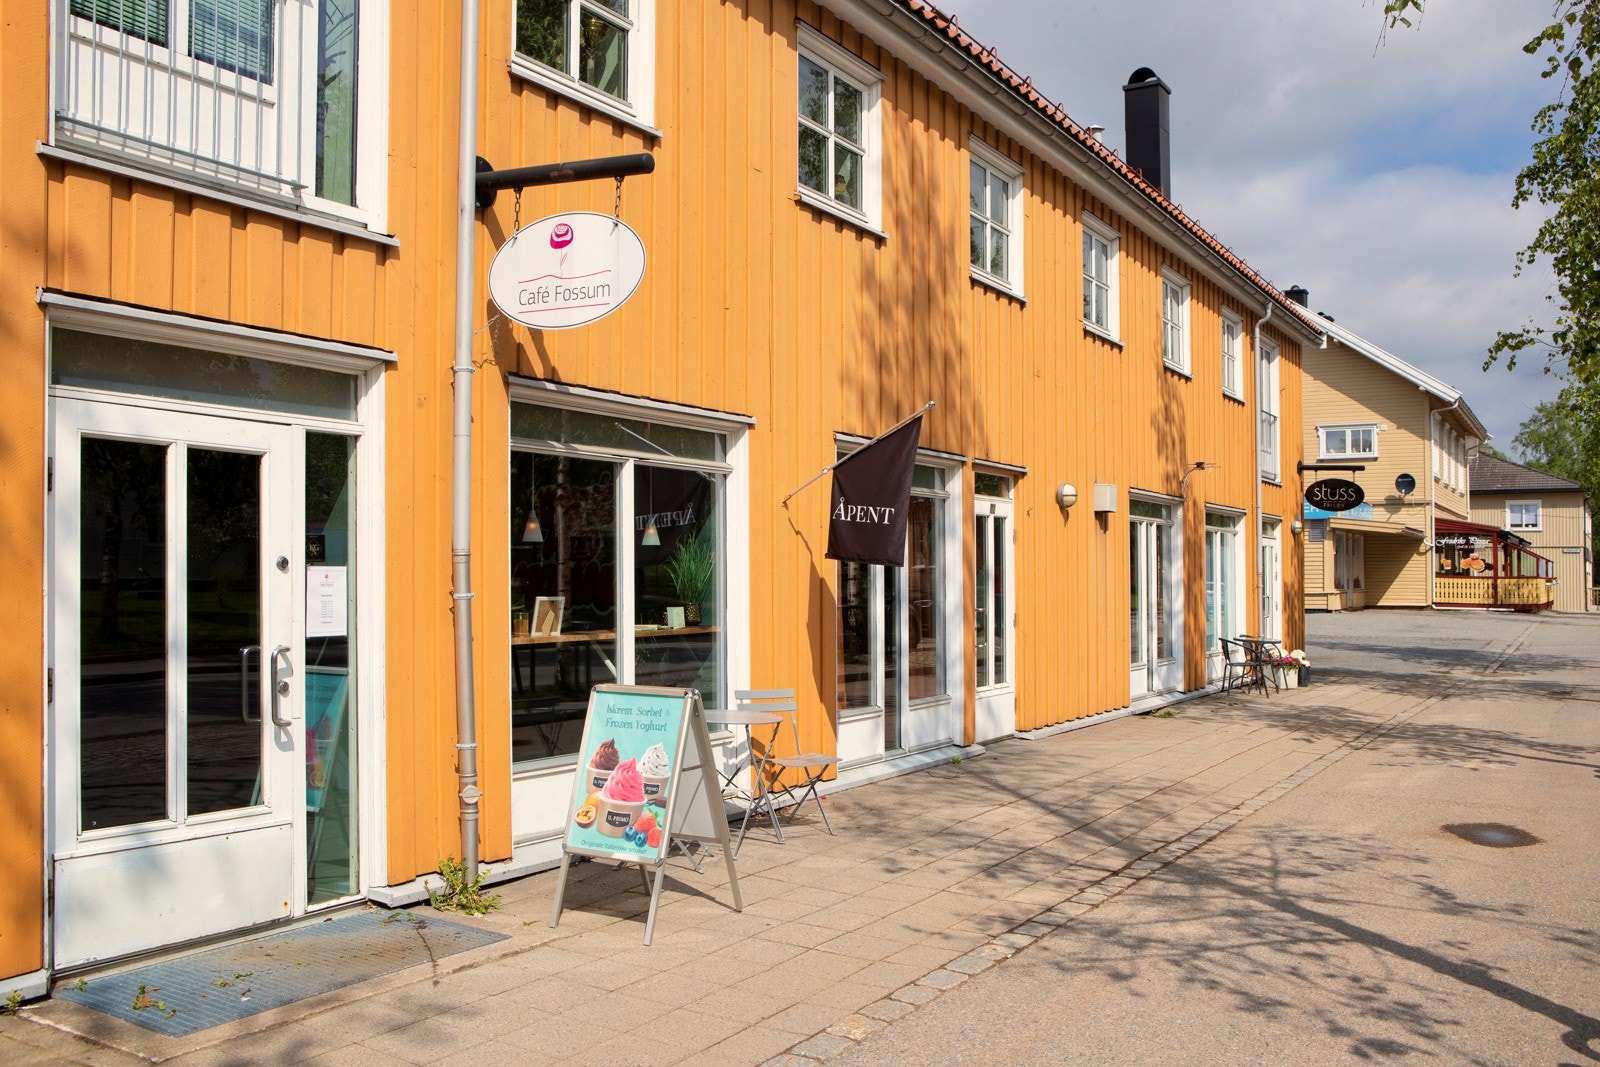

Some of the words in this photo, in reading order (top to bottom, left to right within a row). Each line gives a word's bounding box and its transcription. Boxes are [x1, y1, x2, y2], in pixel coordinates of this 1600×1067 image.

[518, 286, 549, 305] Café
[554, 283, 611, 302] Fossum
[1313, 484, 1356, 501] stuss
[832, 496, 895, 525] ÅPENT
[636, 706, 662, 717] Sorbet
[605, 717, 633, 729] Frozen
[636, 719, 667, 732] Yoghurt
